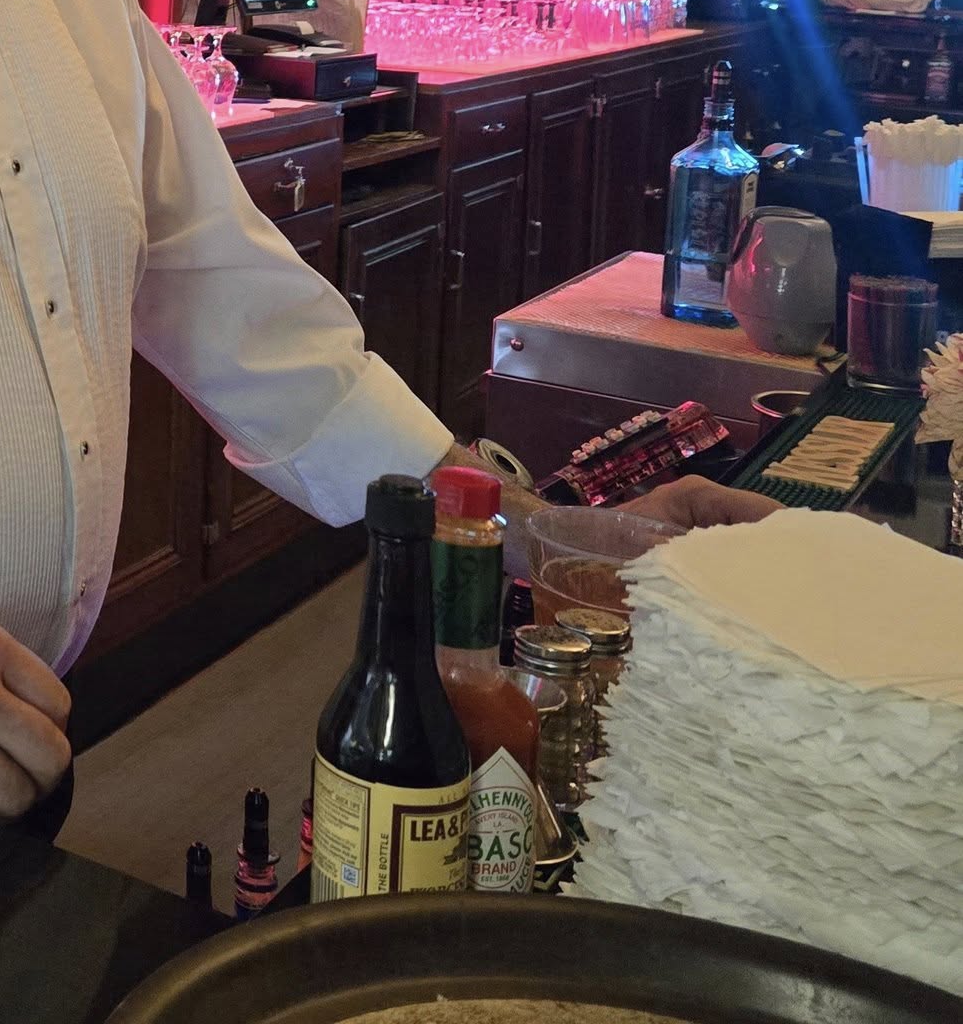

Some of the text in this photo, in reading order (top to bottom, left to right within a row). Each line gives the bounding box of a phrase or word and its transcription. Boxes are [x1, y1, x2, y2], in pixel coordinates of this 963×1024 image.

[468, 825, 532, 862] BASC
[378, 833, 389, 892] THE BOTTLE
[472, 860, 517, 875] BRAND
